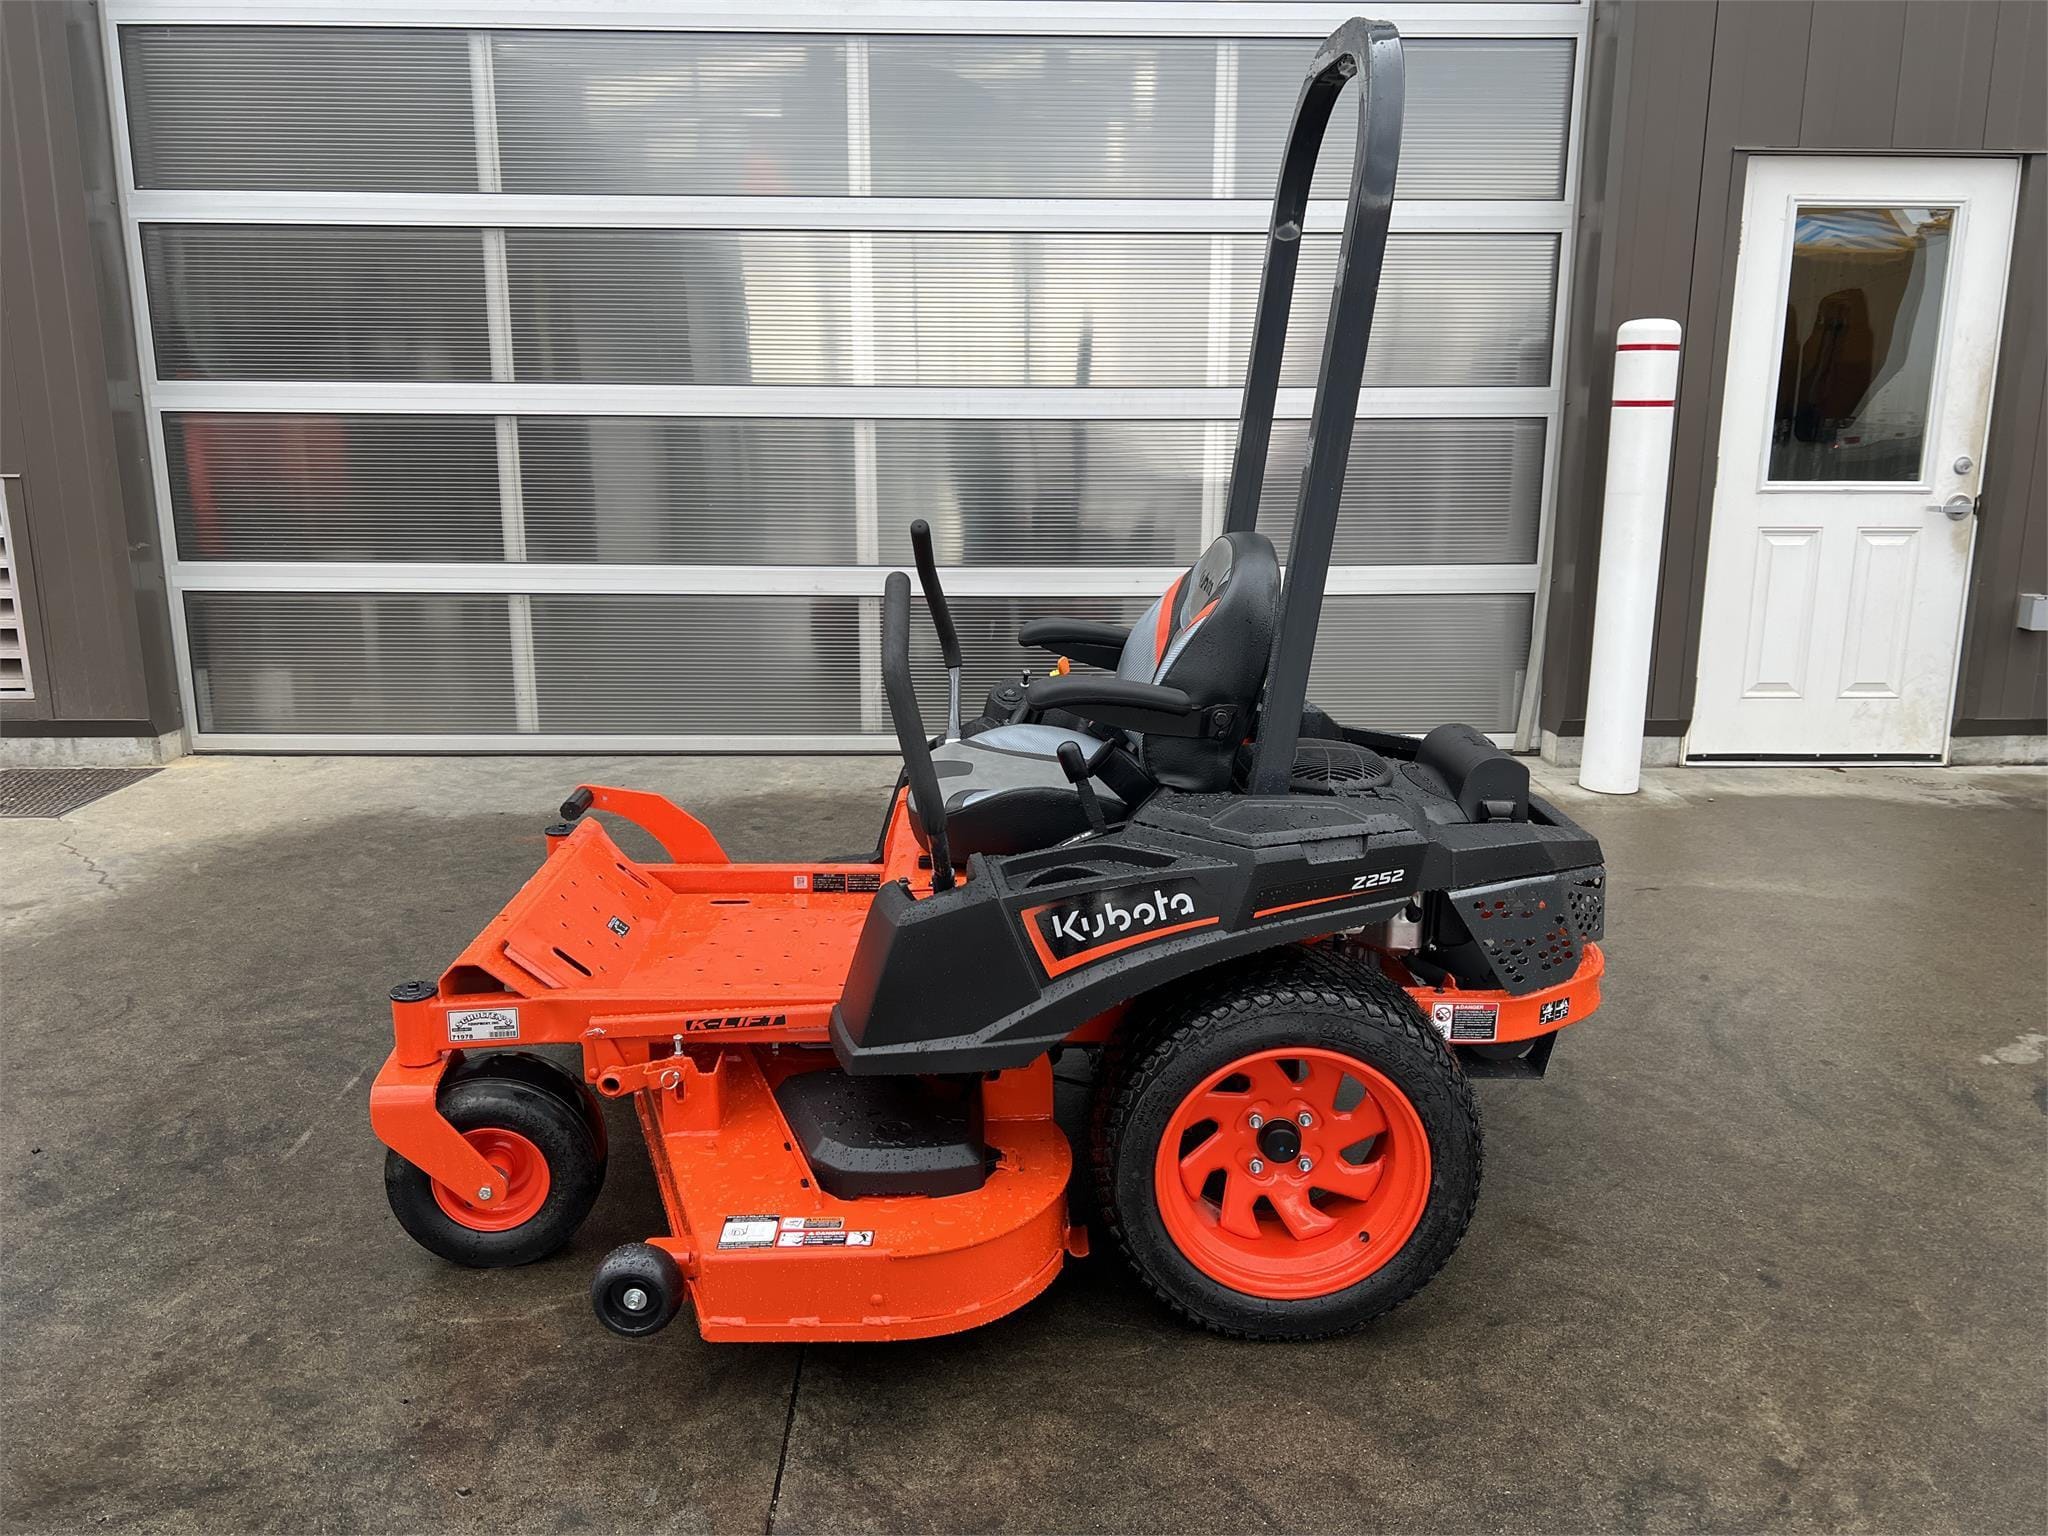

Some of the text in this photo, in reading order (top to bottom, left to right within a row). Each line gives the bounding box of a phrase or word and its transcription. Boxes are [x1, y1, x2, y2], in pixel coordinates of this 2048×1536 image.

[1351, 869, 1405, 890] Z252
[1052, 889, 1196, 942] Kubota
[689, 1015, 784, 1030] K-LIFT
